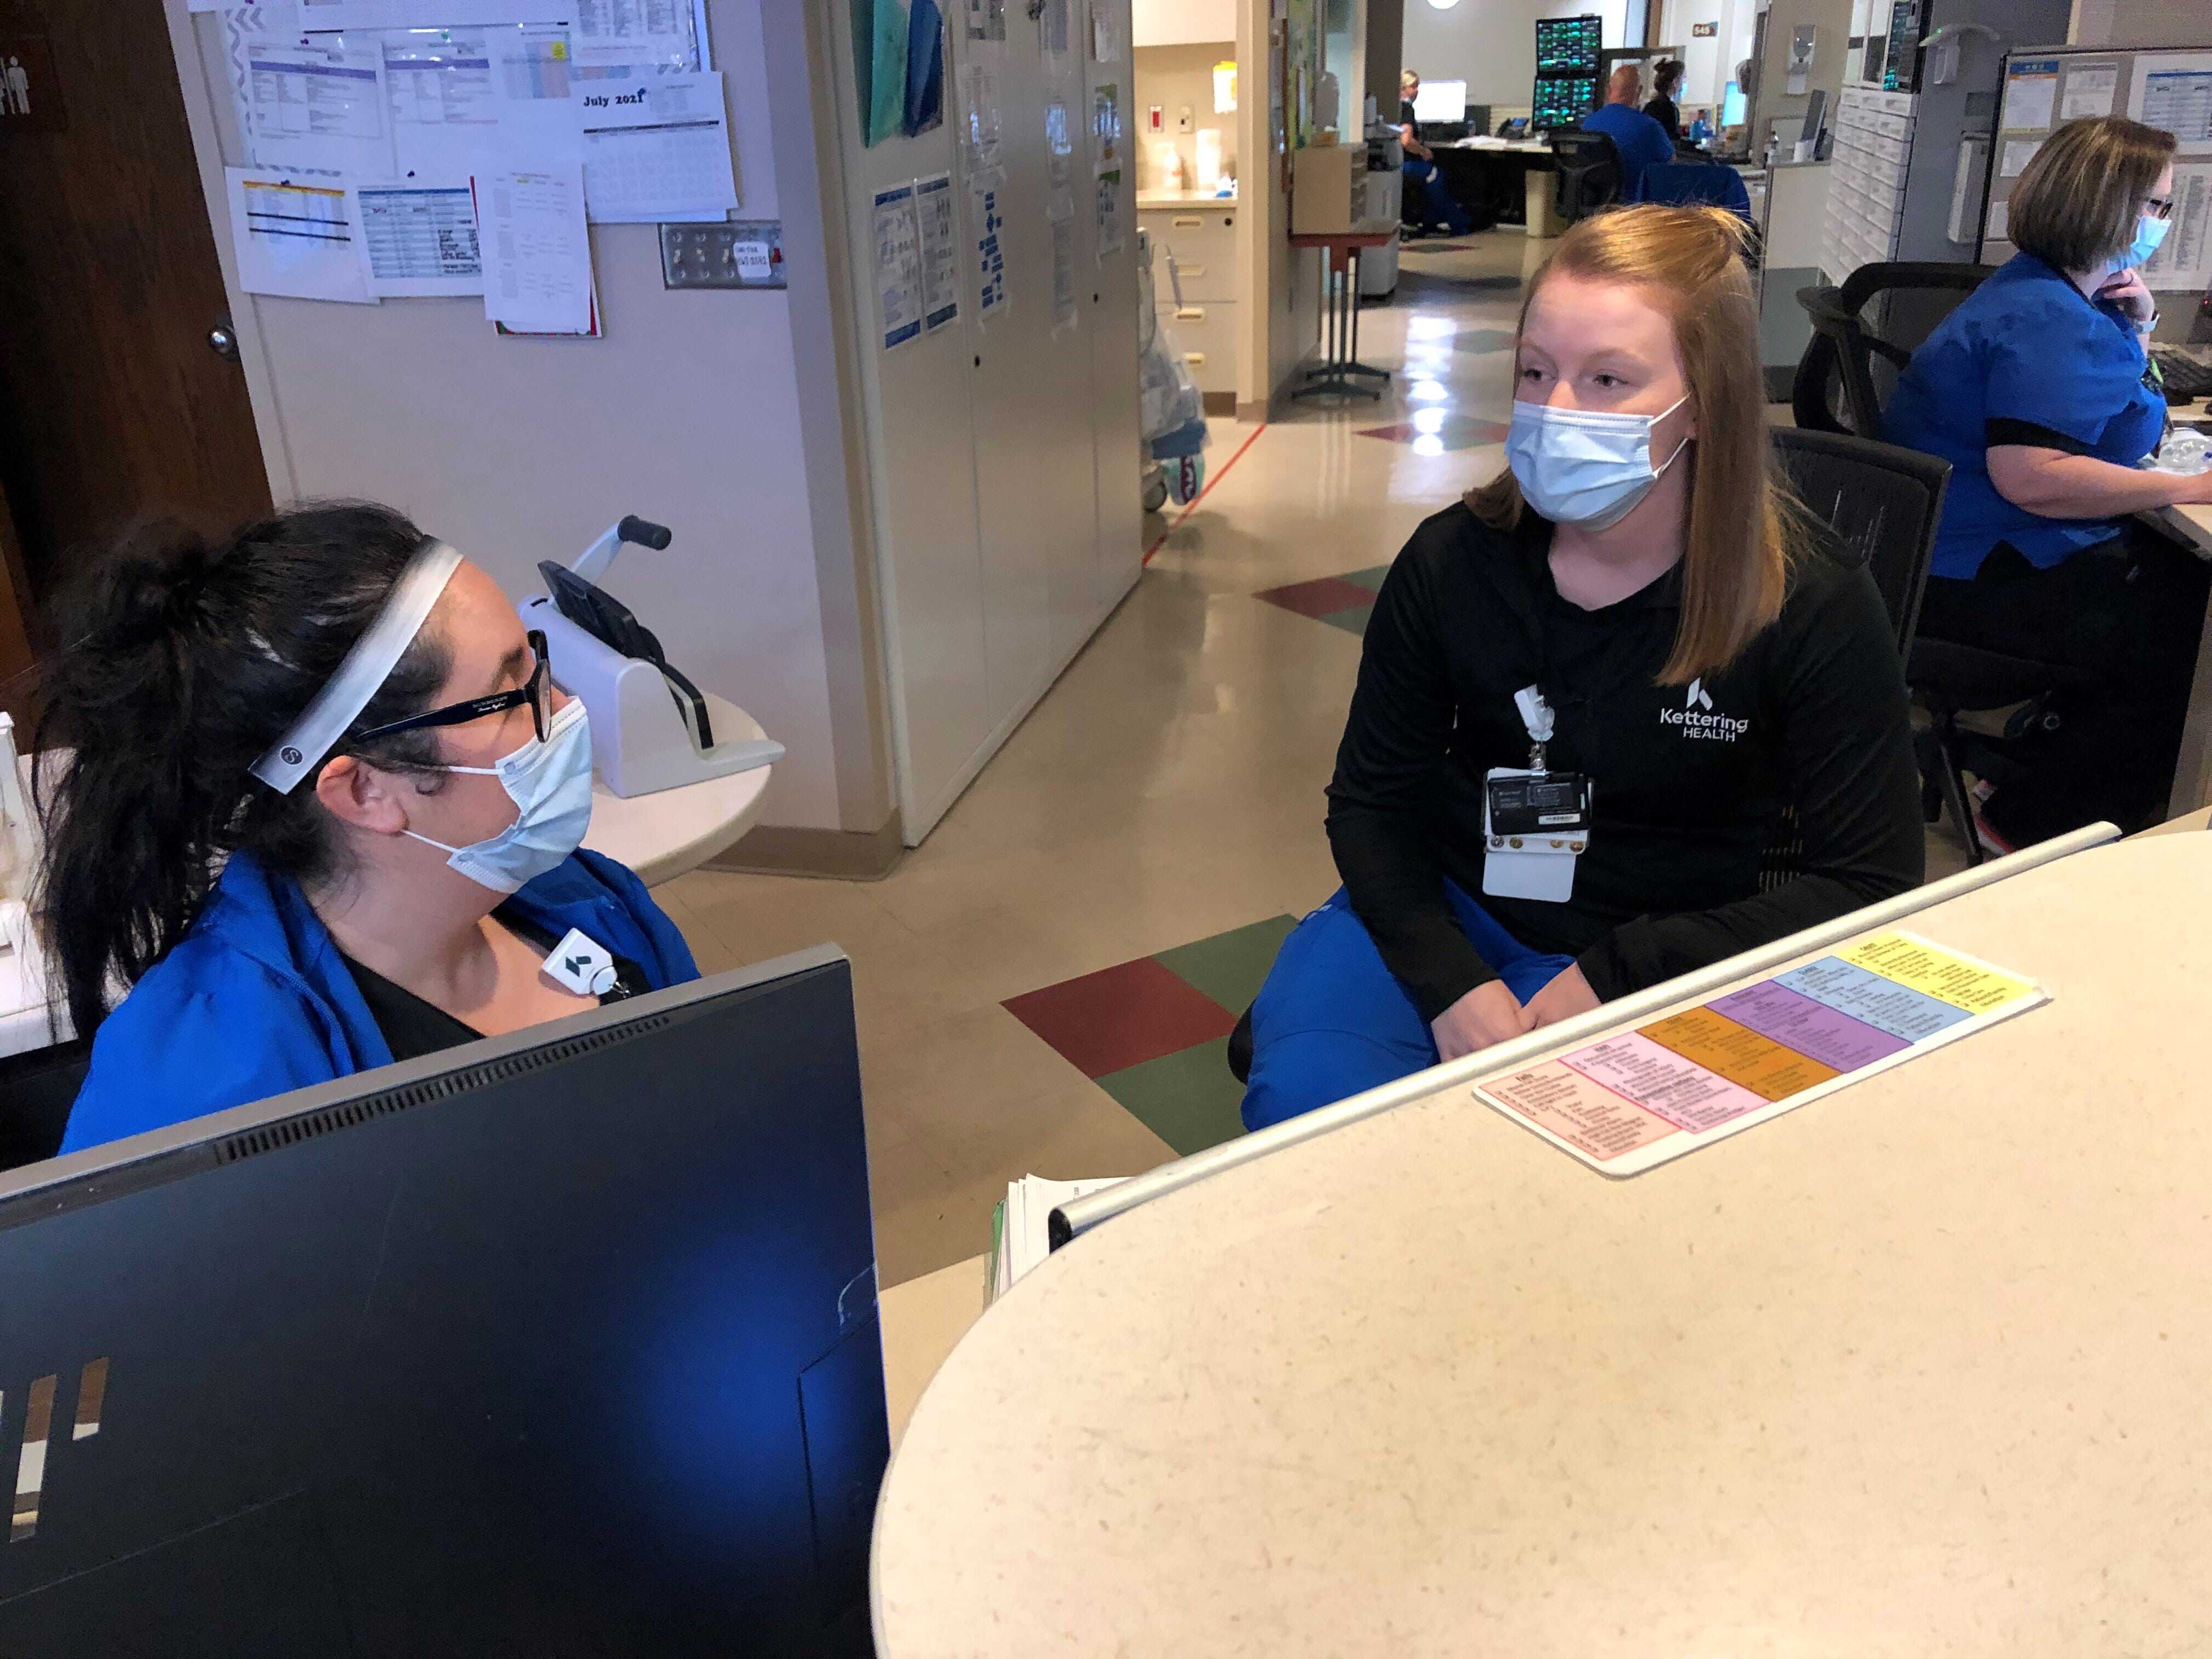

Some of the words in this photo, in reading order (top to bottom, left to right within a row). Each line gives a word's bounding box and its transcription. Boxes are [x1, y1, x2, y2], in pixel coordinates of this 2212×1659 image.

[583, 95, 610, 108] July
[615, 93, 644, 105] 2021
[1660, 708, 1749, 733] Kettering
[1683, 726, 1736, 743] HEALTH
[1515, 1074, 1534, 1082] Falls
